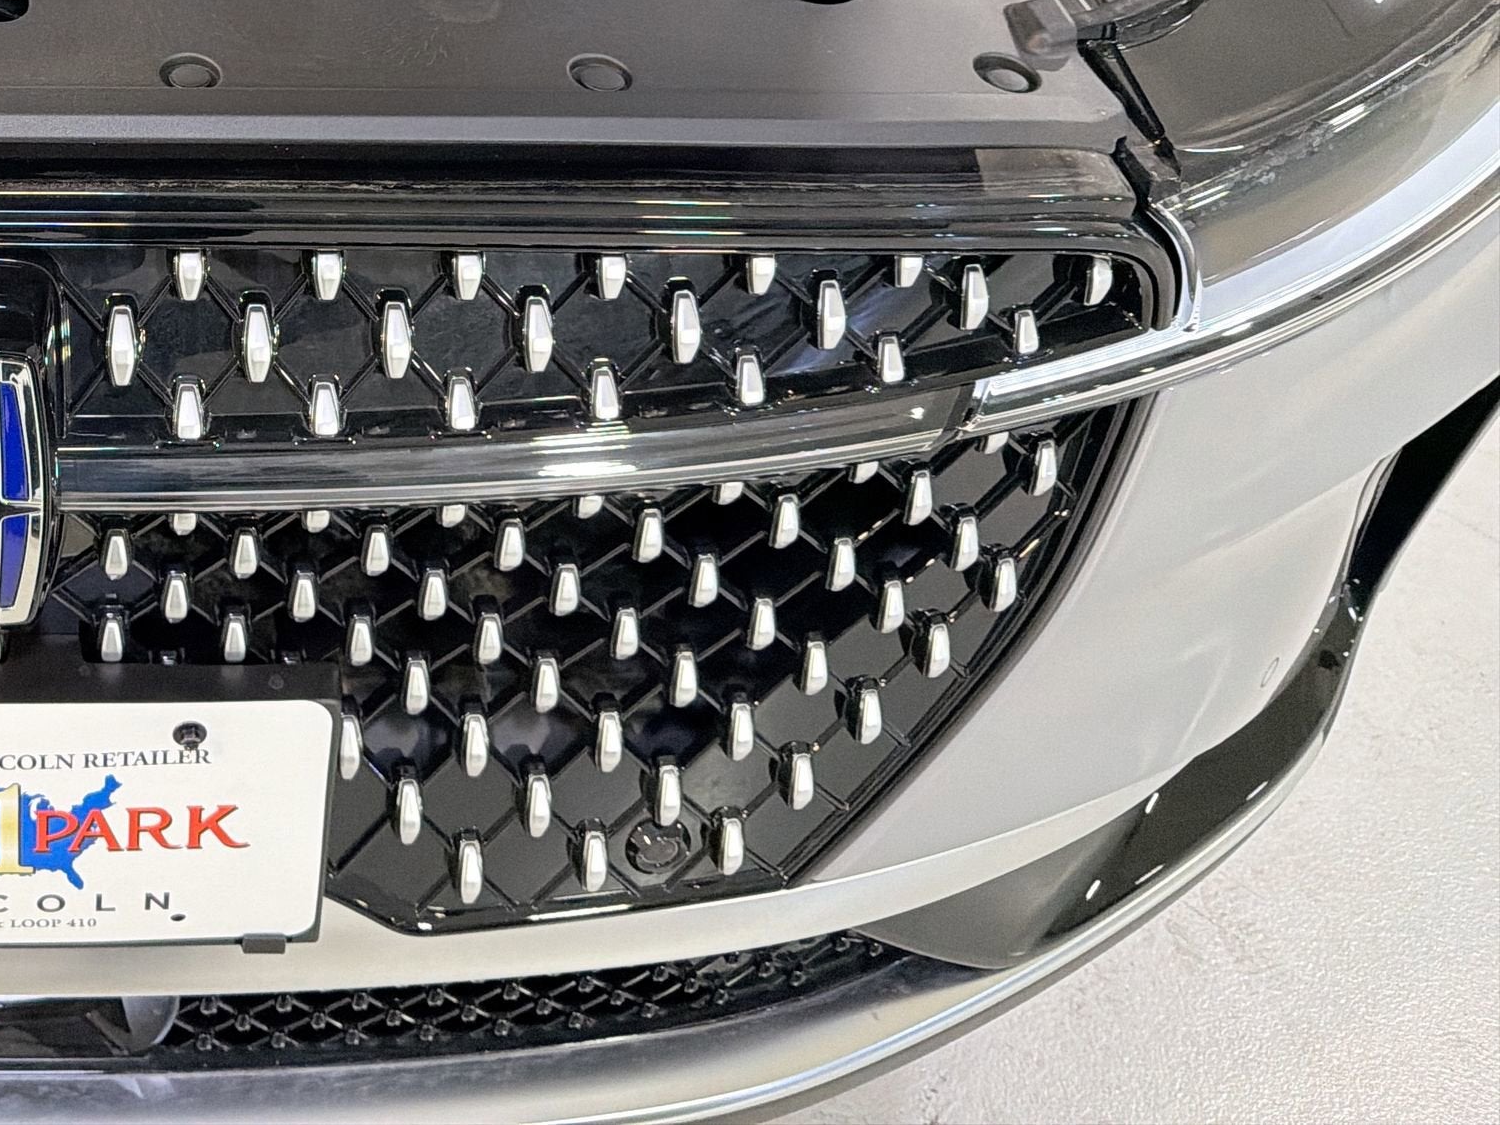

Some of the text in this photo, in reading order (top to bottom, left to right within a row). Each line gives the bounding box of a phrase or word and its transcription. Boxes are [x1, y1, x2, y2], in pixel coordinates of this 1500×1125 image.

[82, 748, 213, 769] RETAILER
[33, 804, 251, 853] PARK
[10, 919, 62, 929] LOOP
[66, 918, 97, 928] 410
